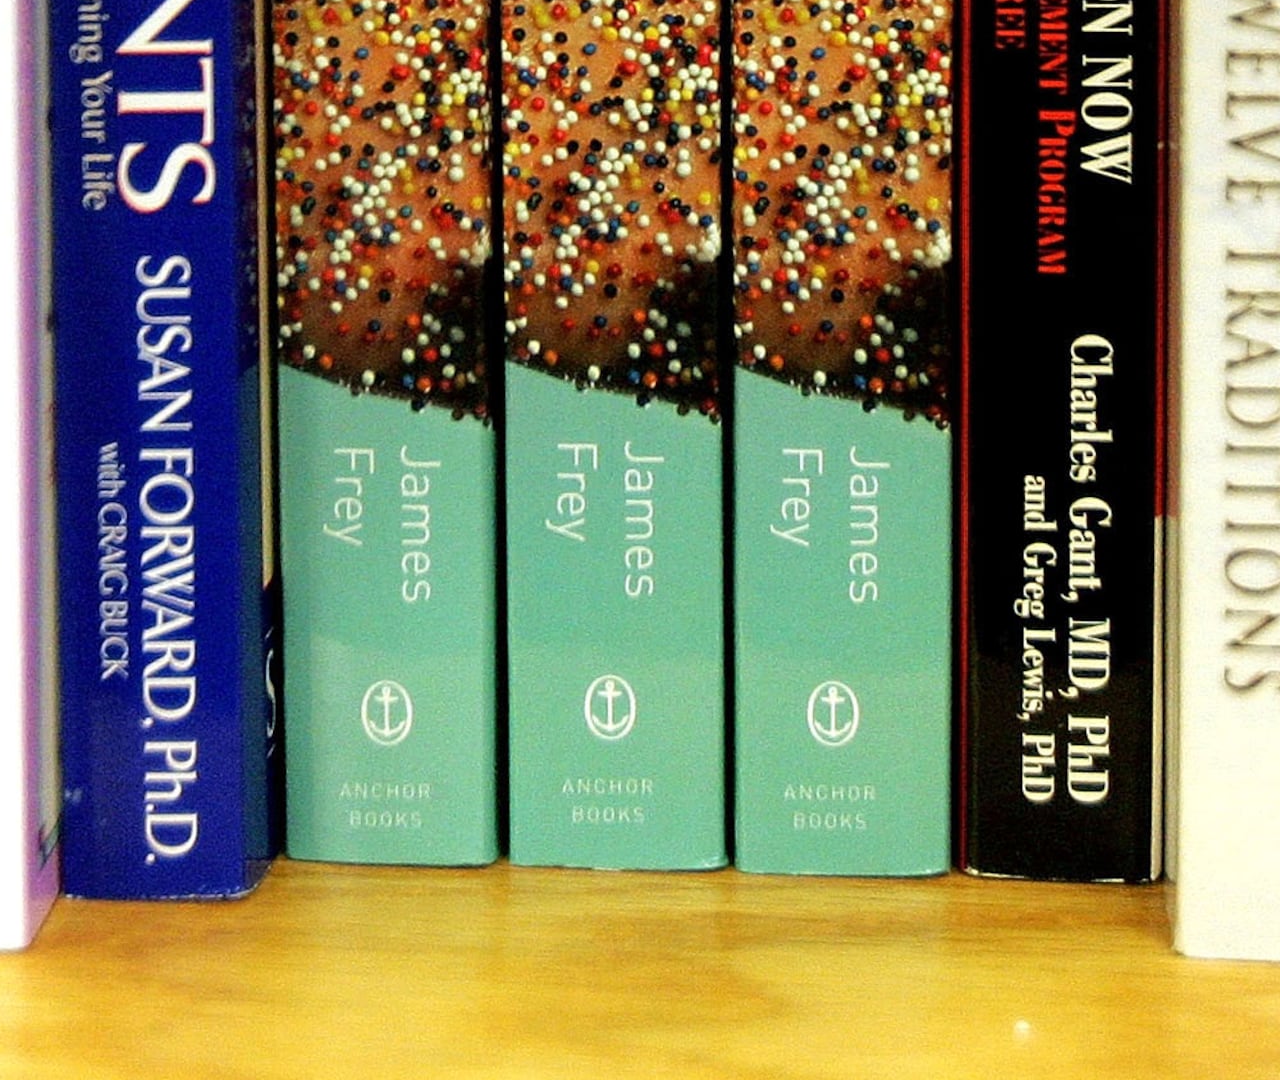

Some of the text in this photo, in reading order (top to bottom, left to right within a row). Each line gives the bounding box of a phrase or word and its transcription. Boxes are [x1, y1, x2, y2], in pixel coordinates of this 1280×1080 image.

[80, 70, 113, 141] Your
[1079, 55, 1134, 186] NOW
[81, 150, 114, 211] Life
[1037, 108, 1076, 277] PROGRAM
[324, 446, 374, 547] Frey
[400, 445, 441, 604] James
[545, 443, 597, 543] Frey
[624, 440, 665, 598] James
[769, 448, 824, 548] Frey
[849, 446, 891, 604] James
[97, 440, 130, 682] with CRAIG BUCK
[135, 254, 199, 865] SUSAN FORWARD, Ph.D.
[1061, 333, 1114, 803] Charles Gant, MD, PhD
[1013, 473, 1058, 803] and Greg Lewis, PhD
[339, 782, 432, 801] ANCHOR
[349, 811, 422, 829] BOOKS
[561, 778, 655, 796] ANCHOR
[570, 806, 646, 824] BOOKS
[783, 783, 877, 802] ANCHOR
[792, 812, 868, 831] BOOKS
